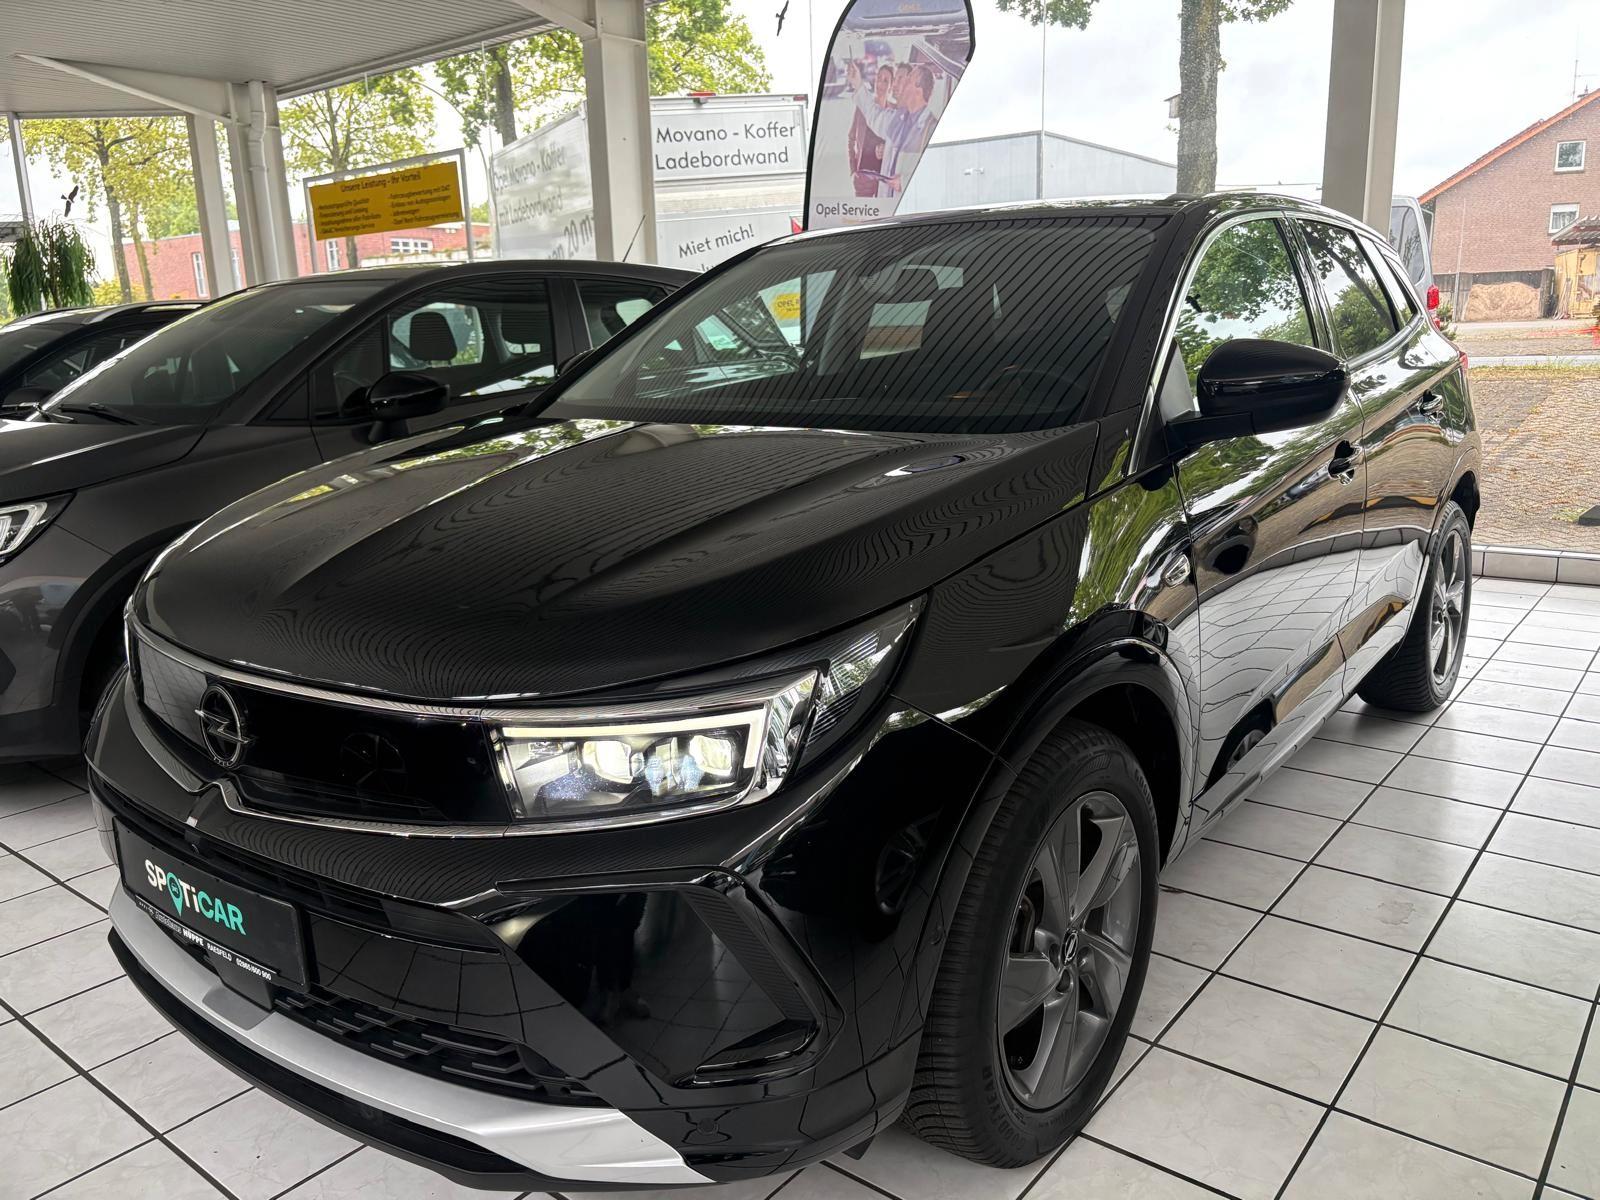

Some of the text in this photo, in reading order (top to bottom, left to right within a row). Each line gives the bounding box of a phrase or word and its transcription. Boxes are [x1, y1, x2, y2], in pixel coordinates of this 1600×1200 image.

[656, 126, 728, 144] Movano
[744, 121, 796, 140] Koffer
[655, 146, 789, 170] Ladebordwand
[815, 203, 879, 218] Opel Service
[678, 223, 754, 259] Miet mich!
